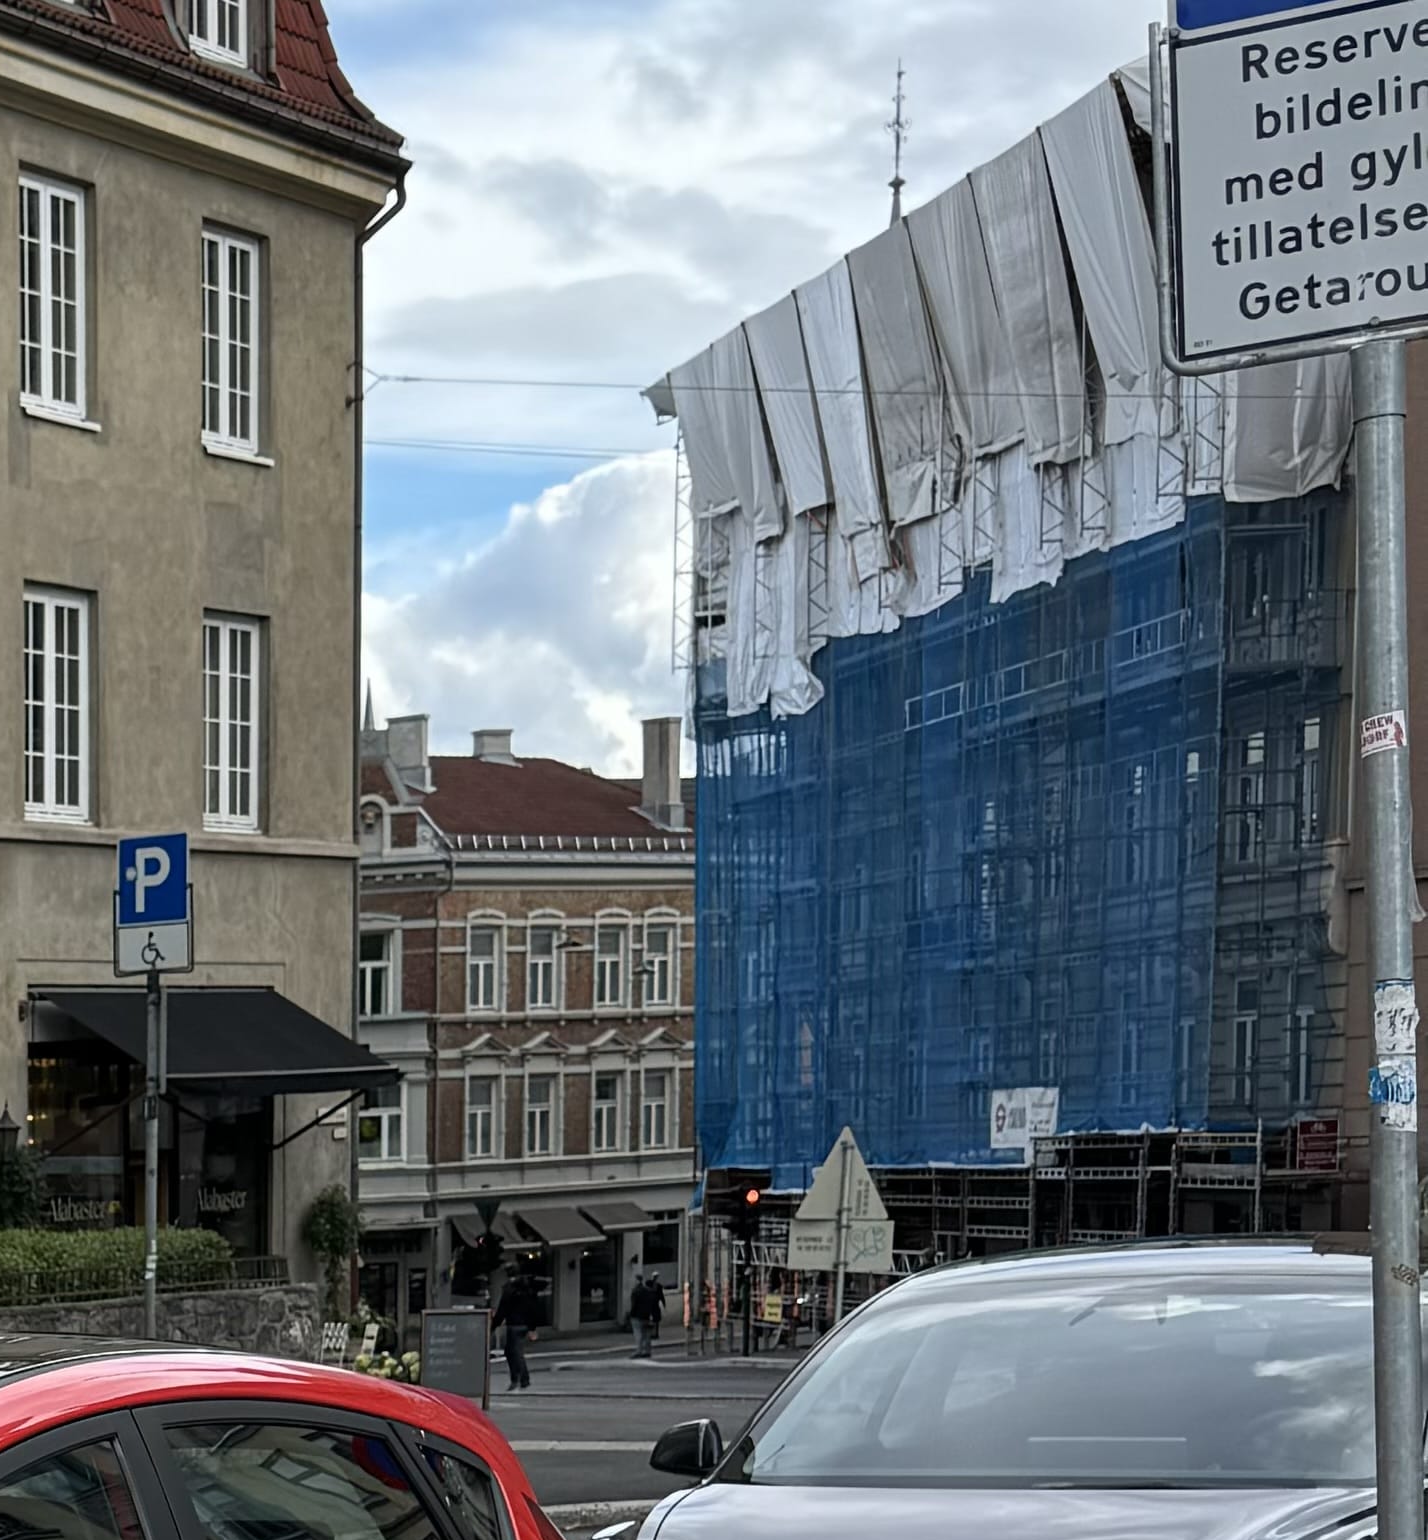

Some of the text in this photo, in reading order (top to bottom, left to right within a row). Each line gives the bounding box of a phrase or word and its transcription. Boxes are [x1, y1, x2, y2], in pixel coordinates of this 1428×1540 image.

[1225, 132, 1428, 205] med gyl
[1211, 202, 1428, 266] tillatelse
[135, 846, 171, 913] P
